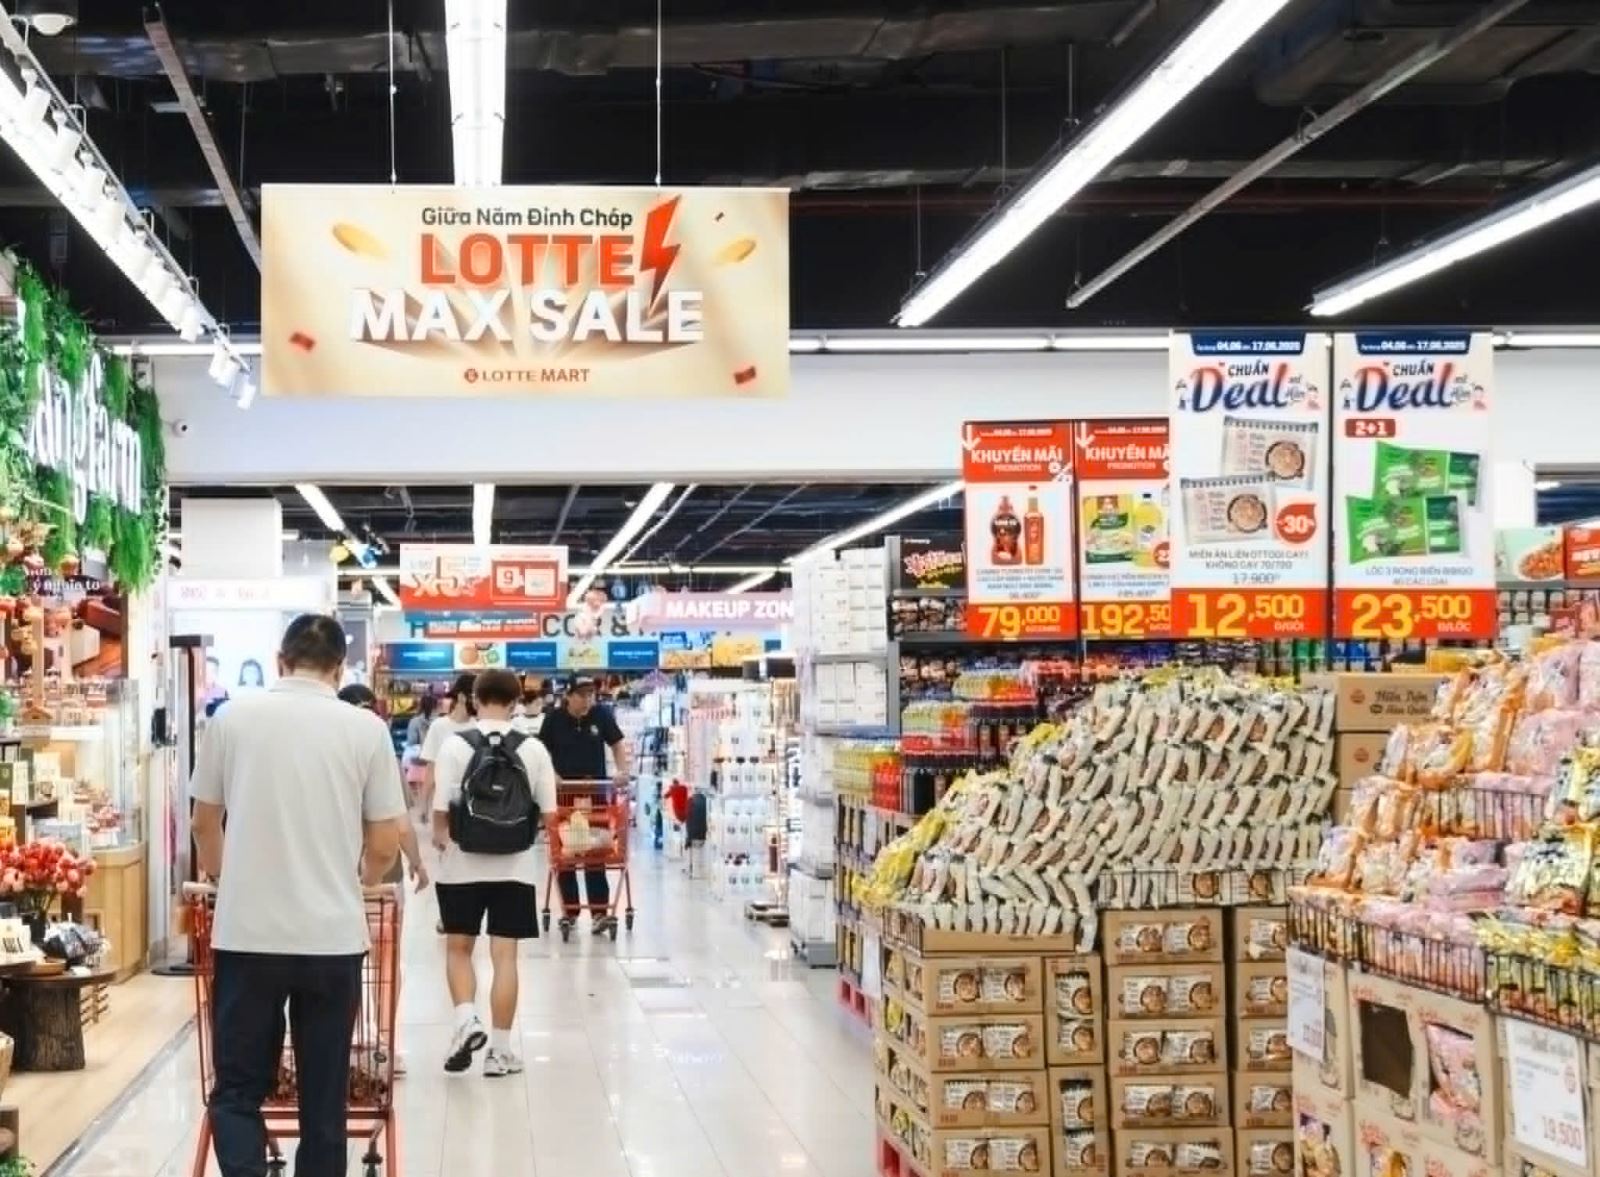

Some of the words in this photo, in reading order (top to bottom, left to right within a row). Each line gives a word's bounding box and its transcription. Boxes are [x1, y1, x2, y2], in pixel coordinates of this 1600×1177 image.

[476, 206, 522, 226] Năm
[420, 233, 635, 286] LOTTE
[350, 289, 512, 342] MAX
[529, 289, 703, 342] SALE
[481, 369, 537, 383] LOTTE
[540, 368, 591, 383] MART
[1190, 362, 1288, 413] Deal
[1354, 362, 1453, 412] Deal
[1355, 421, 1387, 436] 2+1
[666, 600, 751, 618] MAKEUP
[977, 605, 1061, 640] 79,000
[1187, 593, 1305, 638] 12,500
[1351, 593, 1472, 639] 23,500
